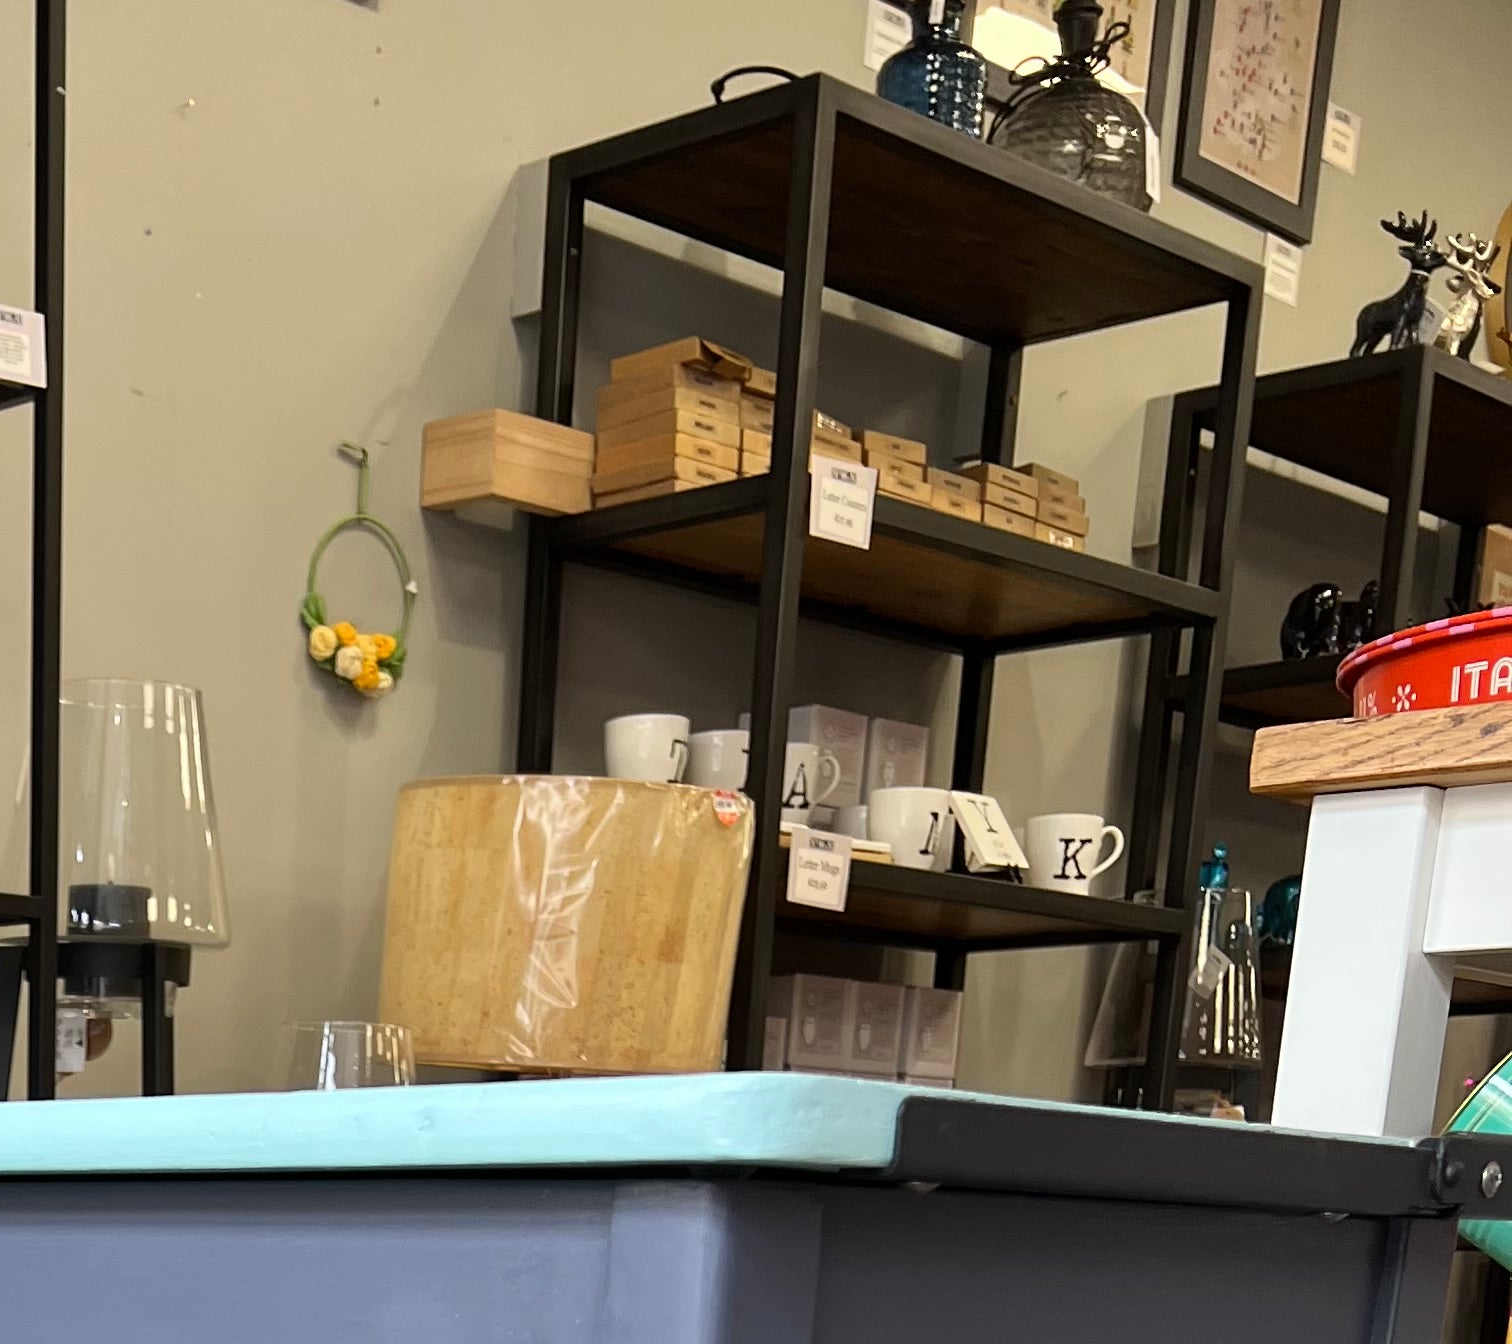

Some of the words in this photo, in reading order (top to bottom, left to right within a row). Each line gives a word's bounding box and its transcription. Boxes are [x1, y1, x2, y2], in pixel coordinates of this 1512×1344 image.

[781, 763, 810, 809] A
[967, 799, 998, 834] Y
[1053, 838, 1093, 880] K
